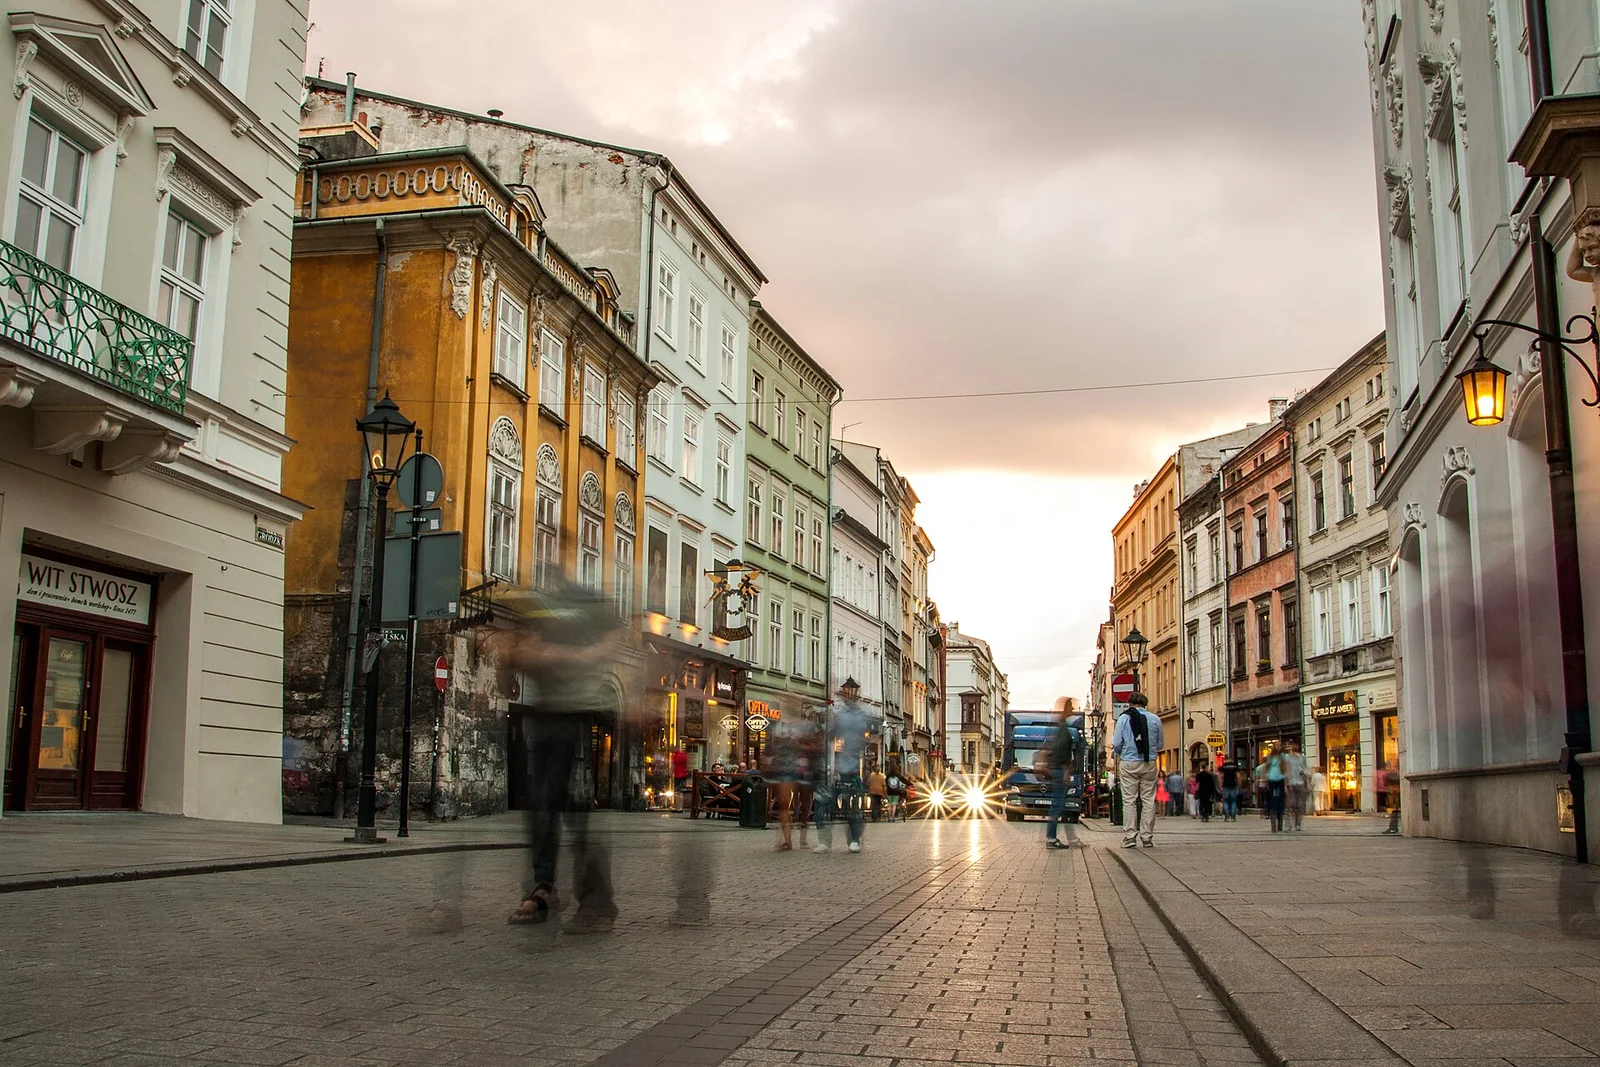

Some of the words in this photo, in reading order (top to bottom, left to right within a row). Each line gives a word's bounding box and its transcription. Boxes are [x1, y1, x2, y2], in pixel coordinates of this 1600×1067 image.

[257, 531, 282, 545] GRODZK
[28, 561, 65, 589] WIT
[69, 572, 138, 606] STWOSZ
[747, 699, 769, 717] OPTYK
[1329, 705, 1337, 715] OF
[1336, 703, 1354, 713] AMBER
